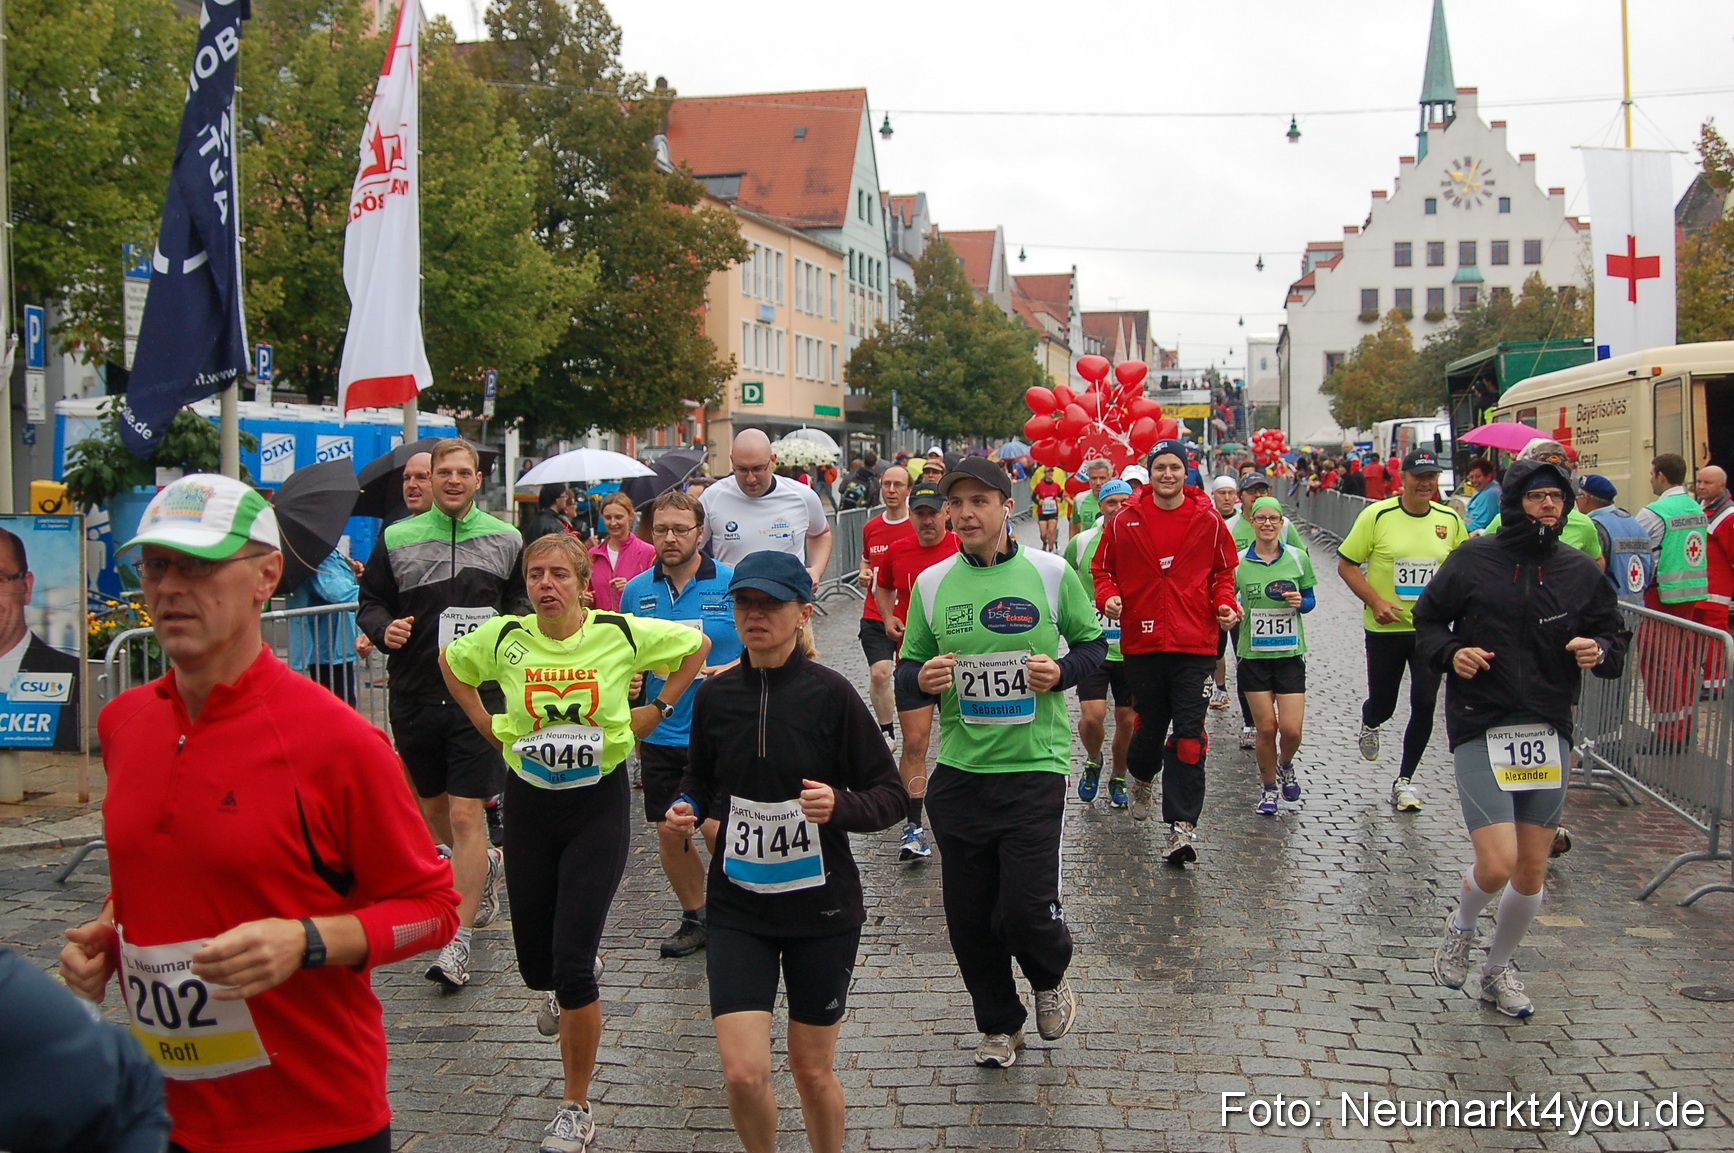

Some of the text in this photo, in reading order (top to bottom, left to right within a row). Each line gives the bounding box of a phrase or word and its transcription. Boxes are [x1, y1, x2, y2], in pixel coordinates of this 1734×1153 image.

[28, 313, 39, 356] P
[259, 350, 270, 377] P
[744, 385, 761, 402] D
[1576, 397, 1627, 424] Bayerisches
[1576, 427, 1600, 445] Rotes
[1577, 451, 1598, 468] Kreuz
[1398, 568, 1434, 584] 3171
[988, 610, 1010, 619] DSG
[1141, 619, 1155, 633] 53
[1255, 618, 1292, 635] 2151
[955, 659, 1018, 668] PARTL Neumarkt
[524, 667, 598, 682] Müller
[961, 668, 1028, 698] 2154
[20, 681, 49, 692] CSU
[972, 703, 1022, 715] Sebastian
[519, 732, 587, 743] PARTL Neumarkt
[1488, 730, 1546, 740] PARTL Neumarkt
[522, 743, 594, 769] 2046
[1504, 740, 1547, 766] 193
[1505, 771, 1548, 781] Alexander
[731, 805, 799, 822] PARTL Neumarkt
[735, 820, 811, 858] 3144
[128, 975, 218, 1030] 202
[159, 1041, 199, 1061] Rofl
